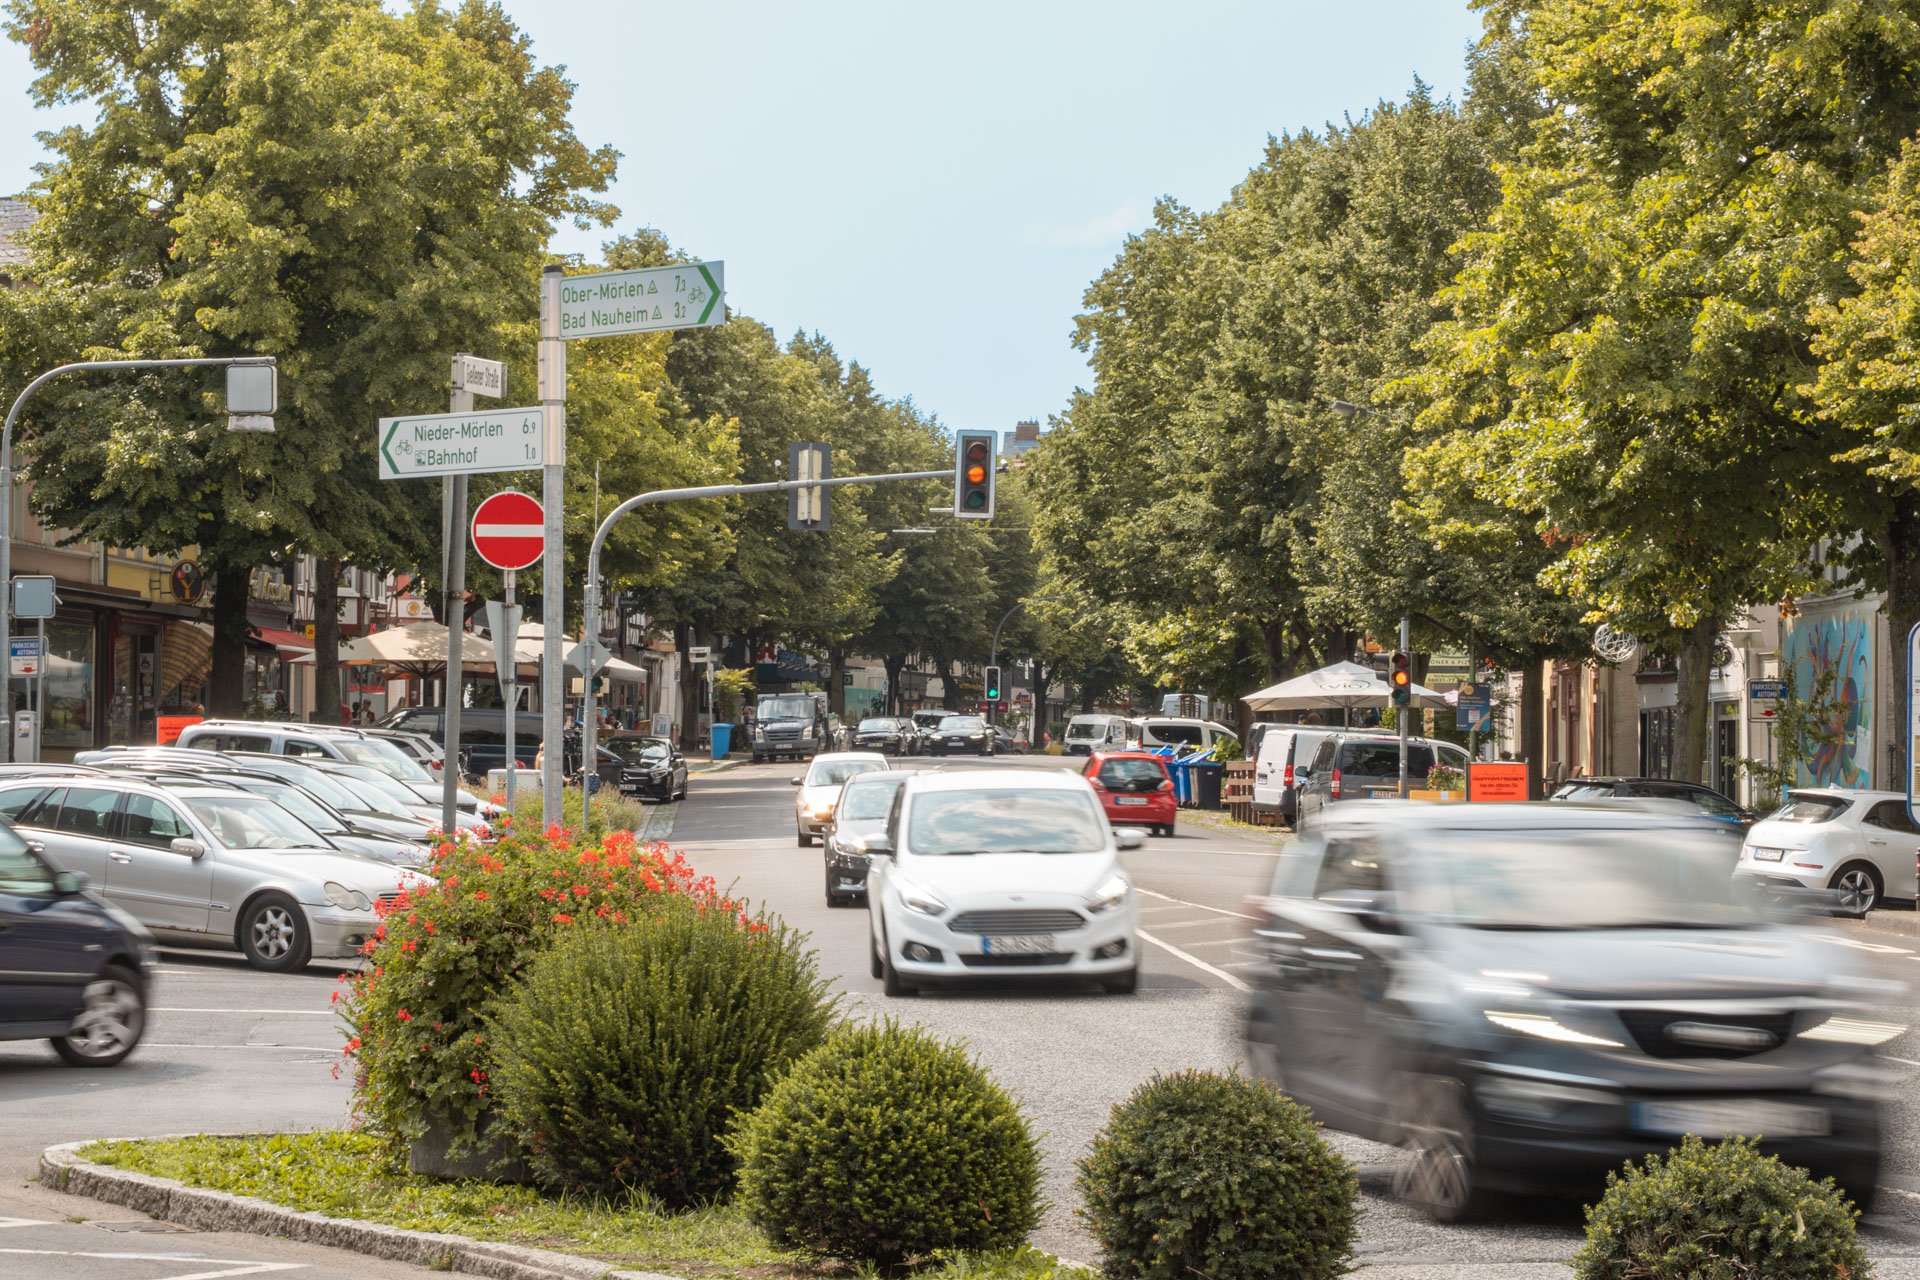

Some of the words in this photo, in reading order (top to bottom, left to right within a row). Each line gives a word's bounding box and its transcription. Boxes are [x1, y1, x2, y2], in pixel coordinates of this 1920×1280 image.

[562, 280, 644, 304] Ober-Mörlen
[562, 311, 586, 330] Bad
[591, 306, 648, 327] Nauheim
[414, 421, 503, 442] Nieder-Mörlen
[427, 446, 478, 466] Bahnhof
[11, 641, 39, 649] PARKSCHEI
